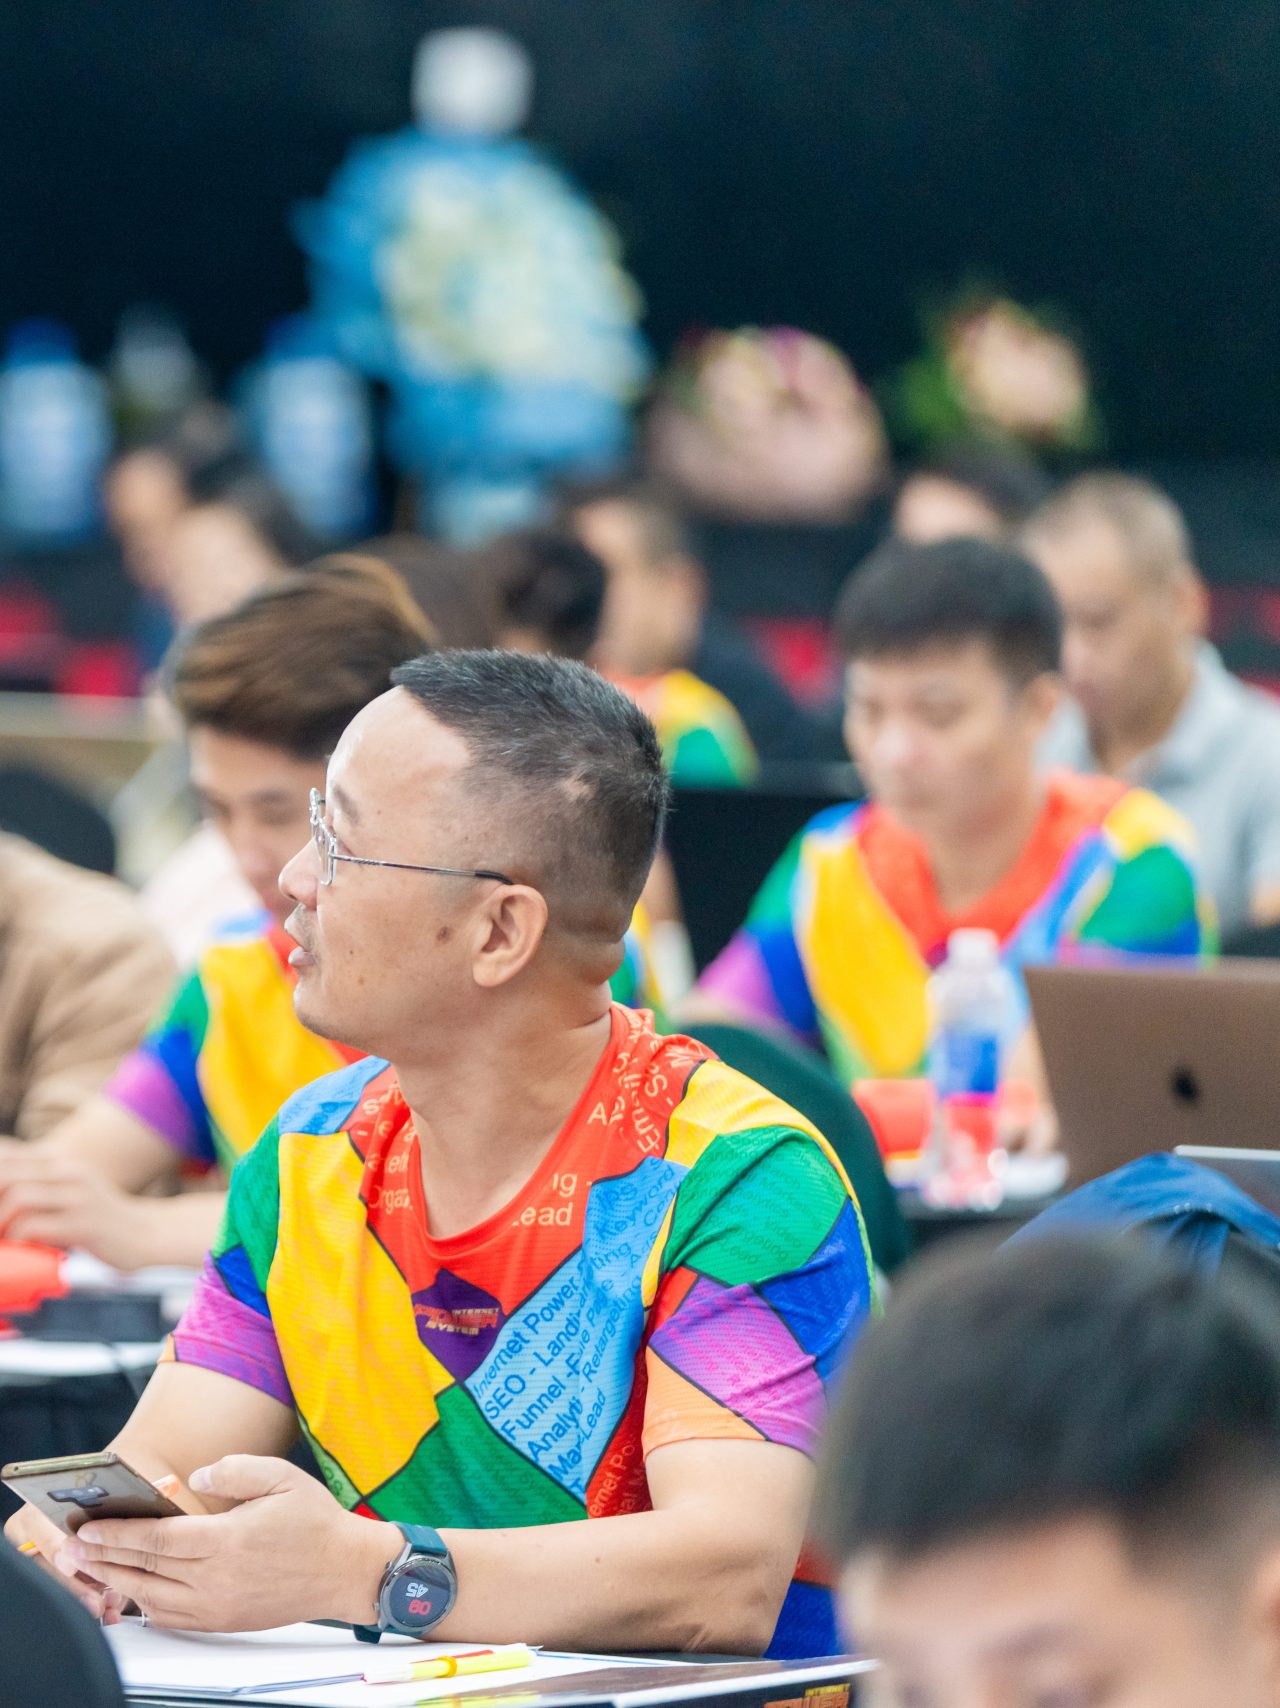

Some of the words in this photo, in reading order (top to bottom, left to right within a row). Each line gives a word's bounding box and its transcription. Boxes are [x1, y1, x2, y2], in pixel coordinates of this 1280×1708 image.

[472, 1328, 532, 1400] Internet
[523, 1275, 580, 1336] Power
[484, 1374, 527, 1420] SEO
[500, 1375, 567, 1442] Funnel
[404, 1582, 429, 1599] 45
